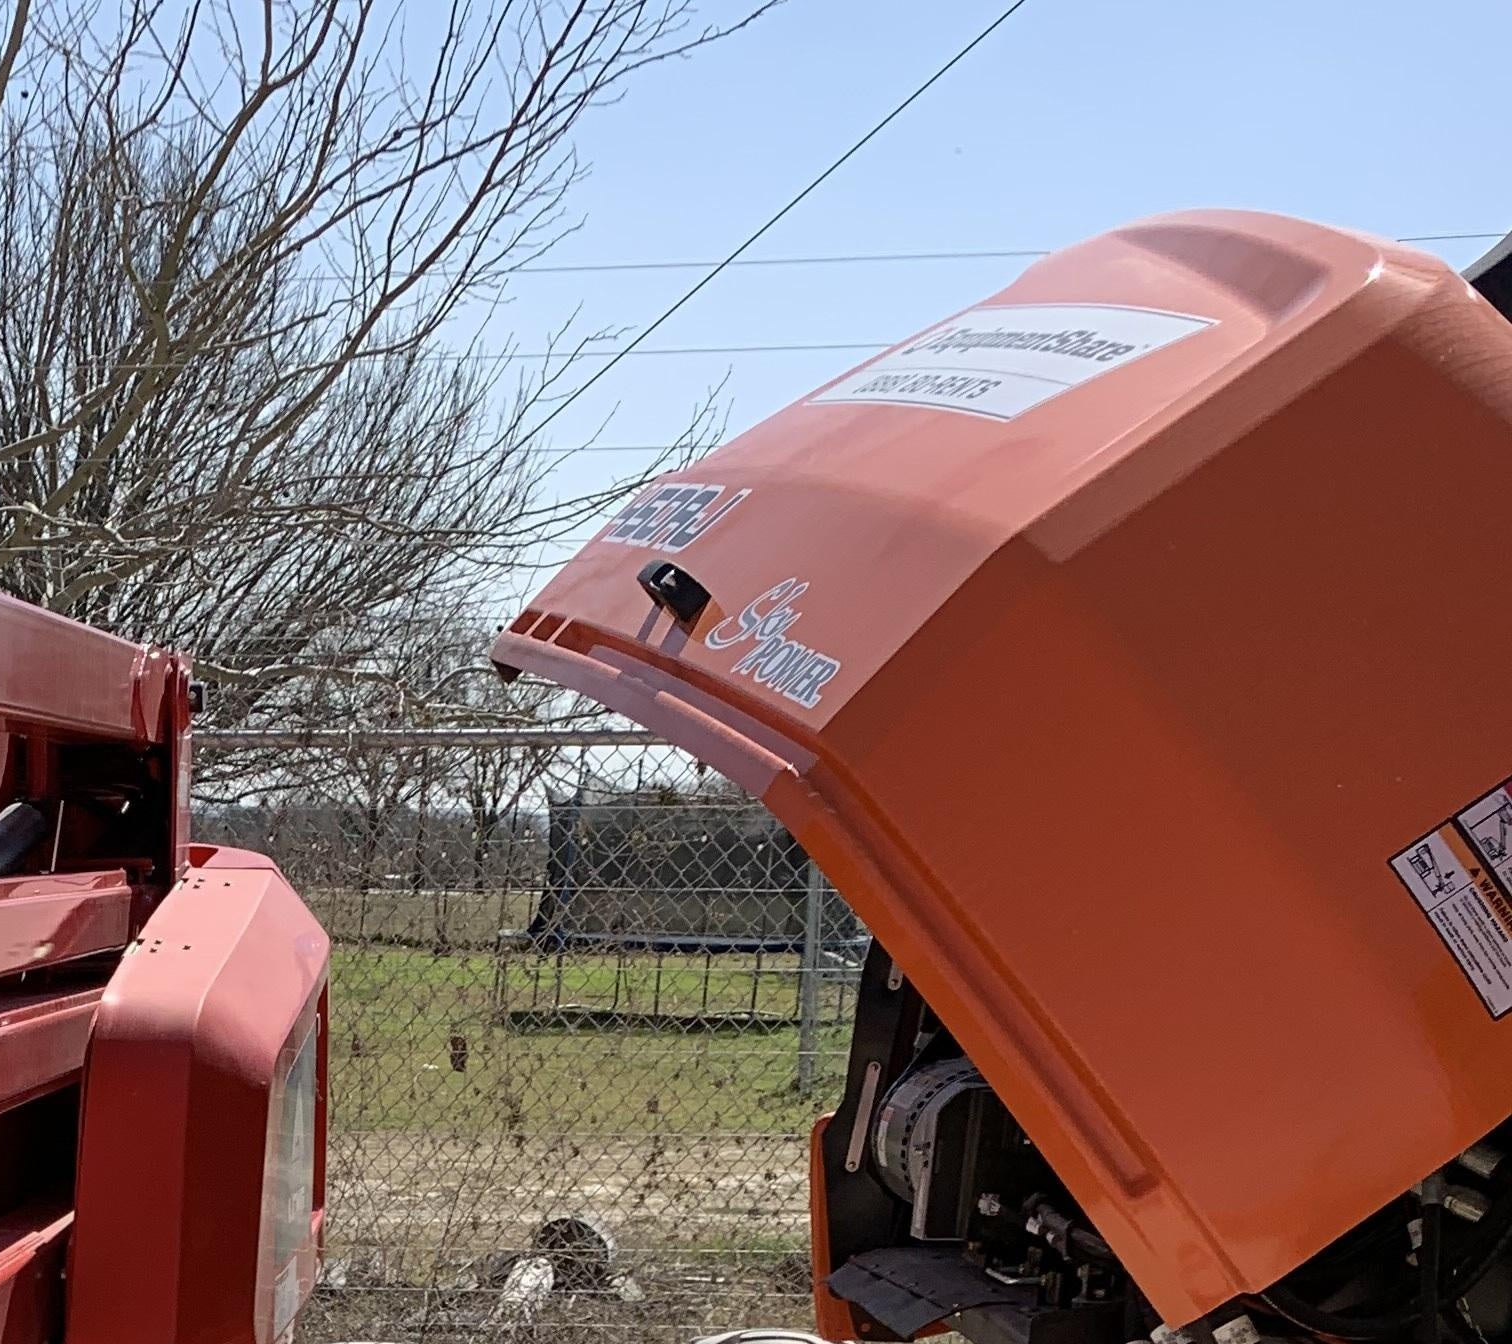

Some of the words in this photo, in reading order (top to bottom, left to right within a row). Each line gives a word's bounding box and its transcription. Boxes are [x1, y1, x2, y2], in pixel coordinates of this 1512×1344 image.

[927, 327, 1135, 362] EquipmentShare
[704, 577, 809, 670] Sky
[739, 637, 841, 709] POWER
